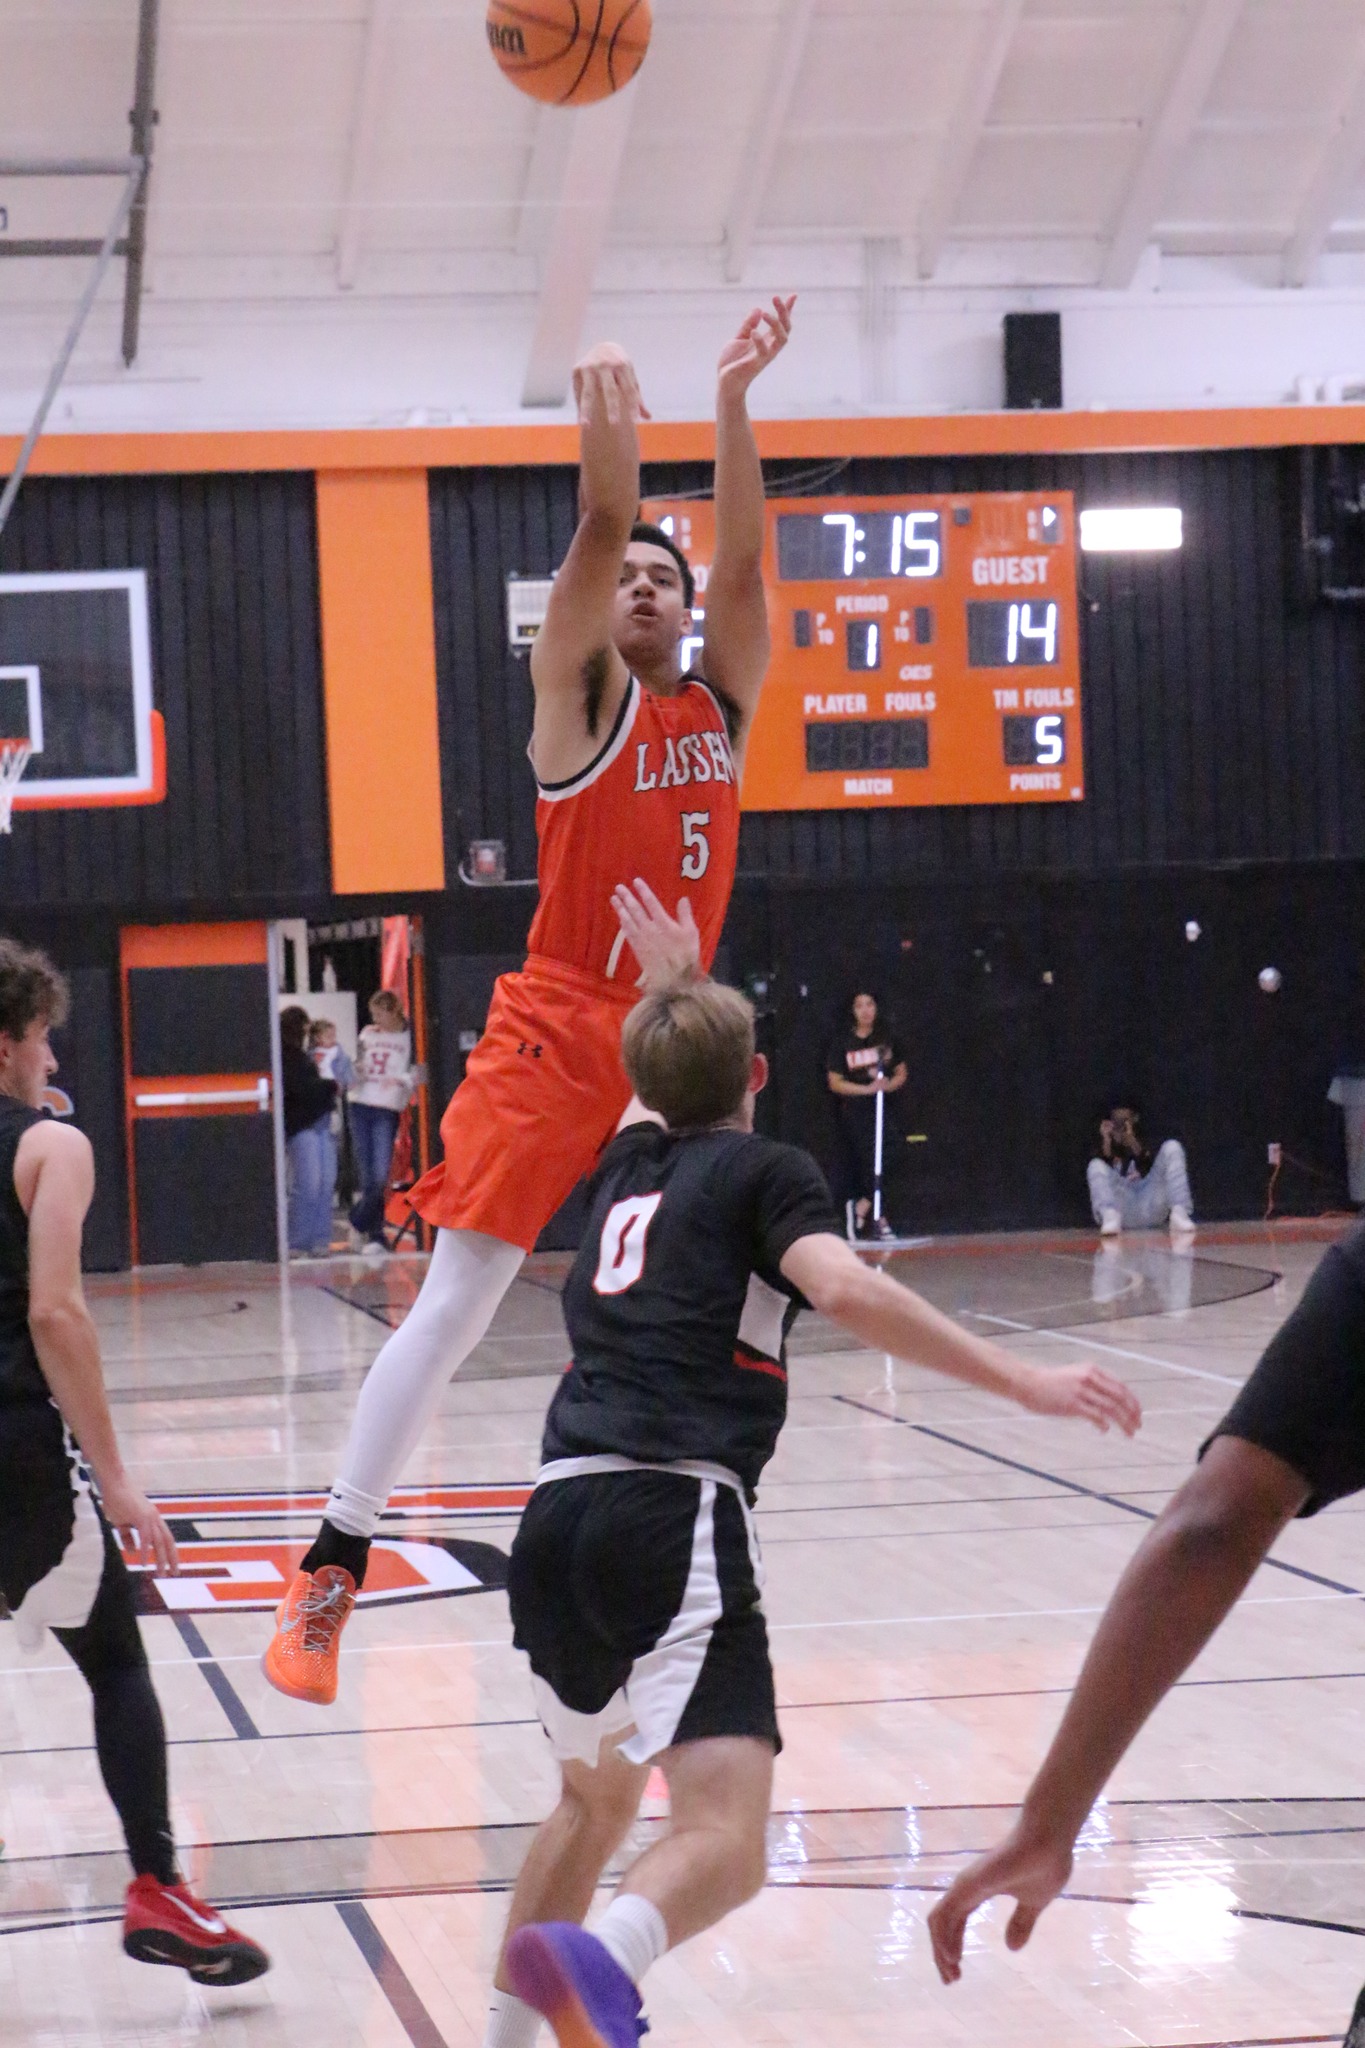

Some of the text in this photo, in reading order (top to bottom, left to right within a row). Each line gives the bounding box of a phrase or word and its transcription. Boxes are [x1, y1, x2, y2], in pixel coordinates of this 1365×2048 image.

[823, 512, 939, 576] 7:15
[972, 555, 1048, 586] GUEST
[835, 595, 889, 613] PERIOD
[866, 624, 878, 667] 1
[1007, 603, 1057, 663] 14
[804, 690, 936, 714] PLAYER FOULS
[993, 687, 1075, 709] TM FOULS
[1036, 716, 1063, 764] 5
[844, 778, 893, 796] MATCH
[1010, 772, 1062, 791] POINTS
[680, 811, 711, 880] 5
[592, 1190, 663, 1296] 0
